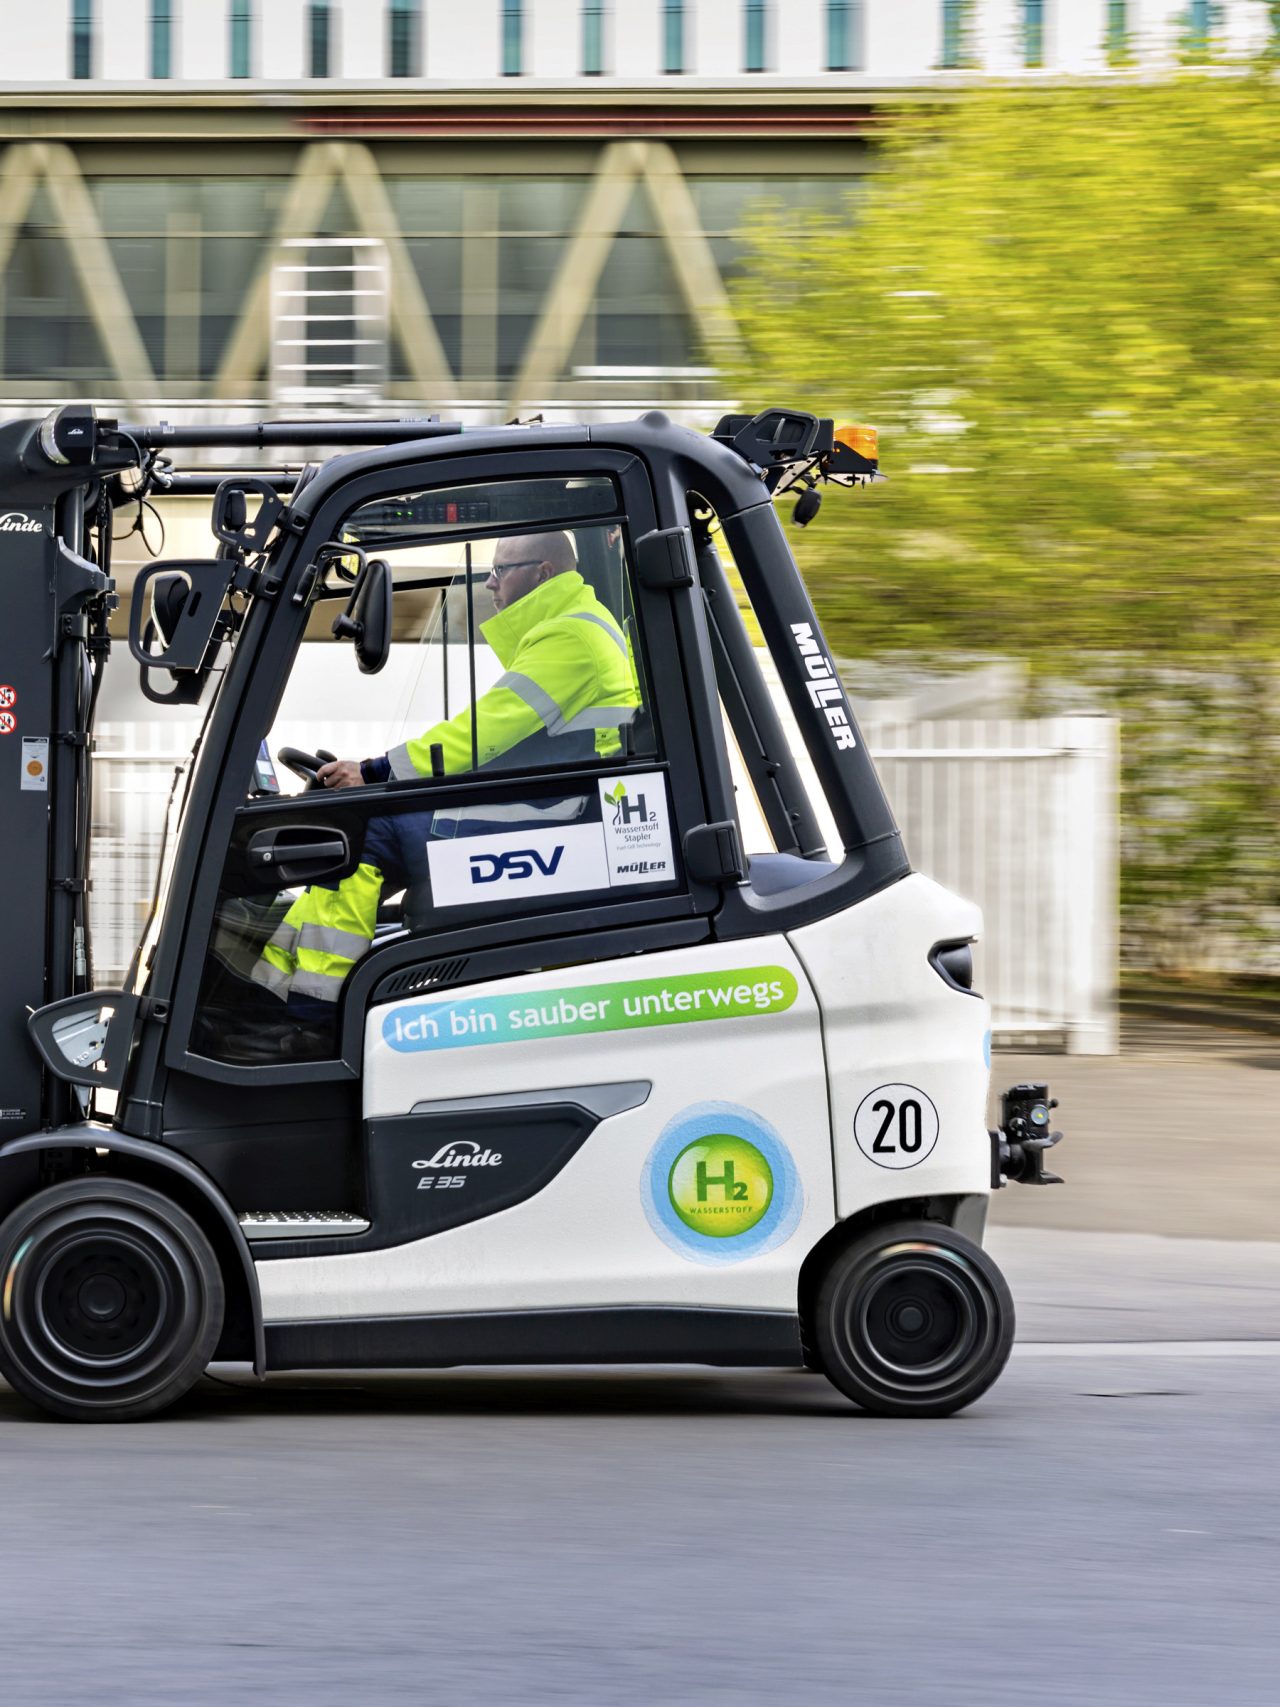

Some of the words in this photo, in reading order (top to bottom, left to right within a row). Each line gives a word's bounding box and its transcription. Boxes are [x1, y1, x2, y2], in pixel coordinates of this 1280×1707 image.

[789, 622, 857, 751] MÜLLER
[614, 823, 659, 834] Wasserstoff
[624, 834, 651, 842] Stapler
[469, 845, 565, 885] DSV
[617, 861, 666, 874] MÜLLER
[394, 1013, 439, 1042] Ich
[450, 1008, 498, 1036] bin
[509, 998, 610, 1029] sauber
[624, 978, 784, 1017] unterwegs
[871, 1099, 922, 1154] 20
[411, 1140, 503, 1169] Linde
[417, 1176, 435, 1190] E
[434, 1175, 467, 1189] 35
[689, 1205, 753, 1215] WASSERSTOFF
